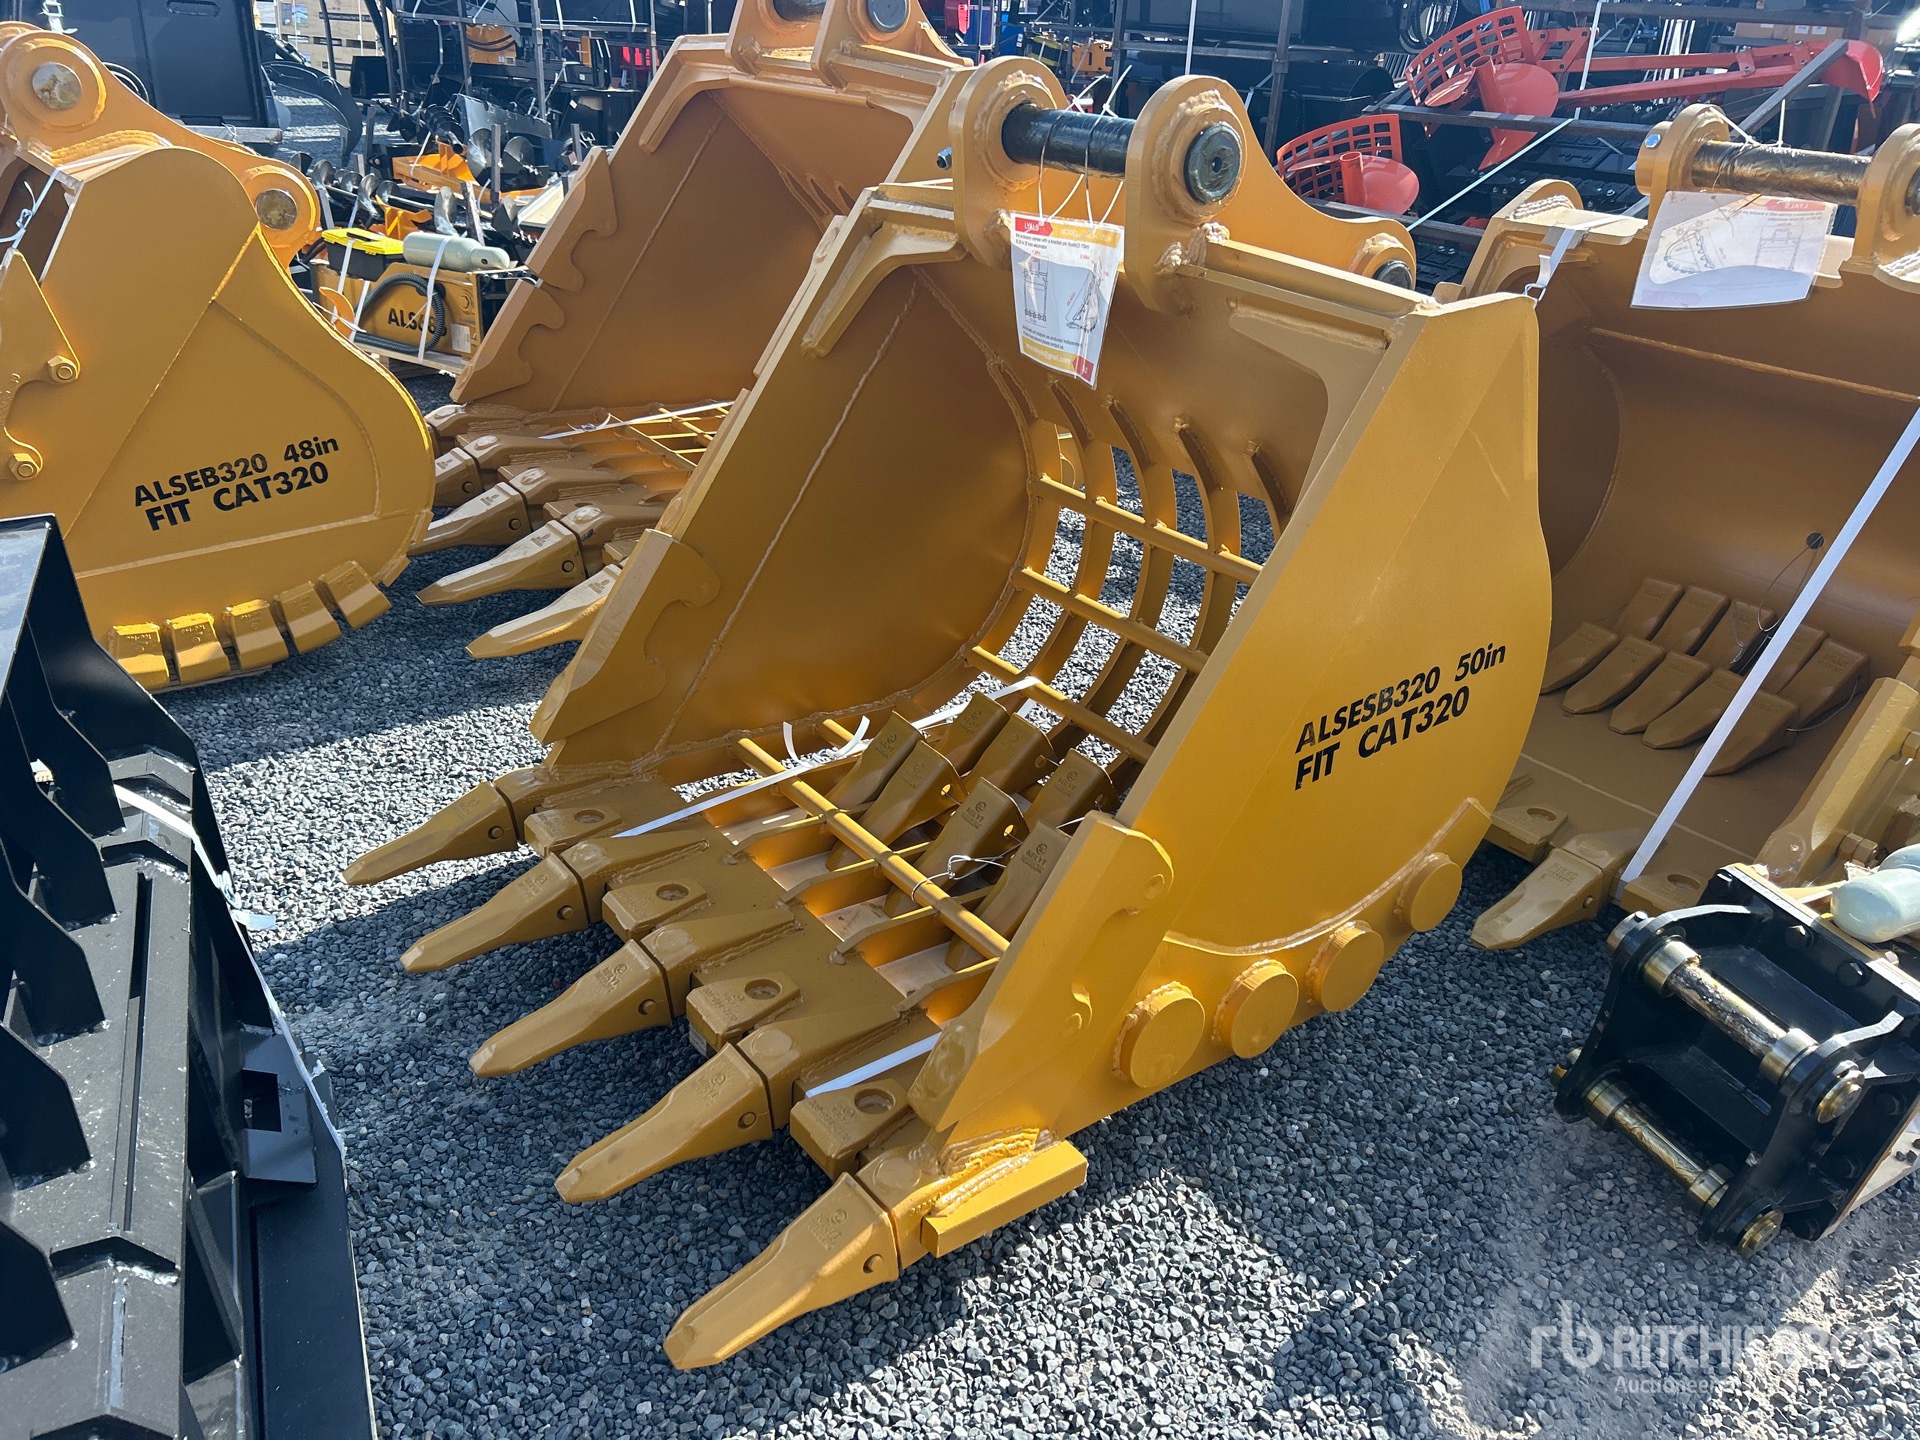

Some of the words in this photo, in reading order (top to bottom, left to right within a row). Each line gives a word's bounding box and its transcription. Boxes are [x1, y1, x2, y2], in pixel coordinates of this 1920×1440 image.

[135, 453, 268, 507] ALSEB320
[283, 436, 339, 463] 48in
[145, 498, 191, 531] FIT
[213, 461, 328, 511] CAT320
[1295, 666, 1441, 754] ALSESB320
[1454, 643, 1506, 682] 50in
[1295, 741, 1341, 791] FIT
[1358, 685, 1470, 758] CAT320
